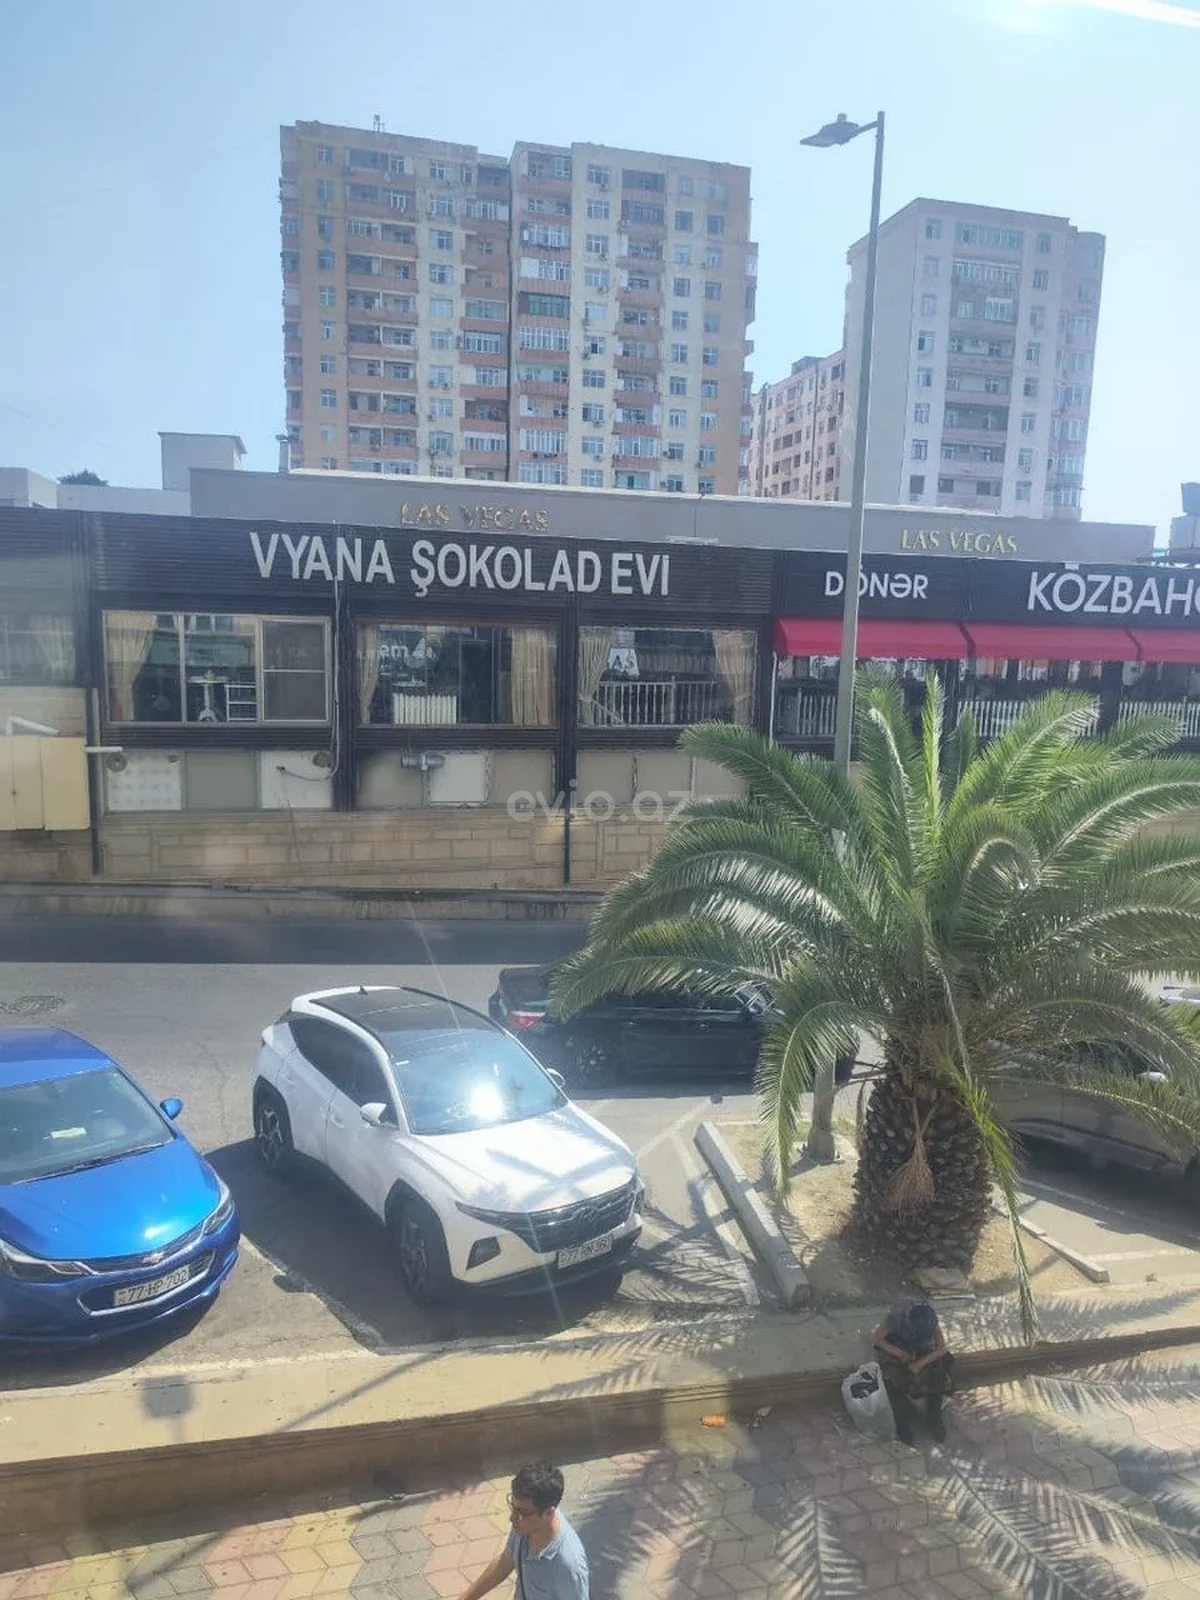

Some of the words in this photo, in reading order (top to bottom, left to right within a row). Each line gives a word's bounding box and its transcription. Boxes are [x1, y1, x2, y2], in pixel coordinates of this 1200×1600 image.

[400, 503, 450, 525] LAS
[901, 529, 940, 551] LAS
[949, 530, 1018, 554] VEGAS
[250, 532, 395, 585] VYANA
[410, 539, 601, 598] ŞOKOLAD
[1027, 563, 1200, 616] KÖZBAH
